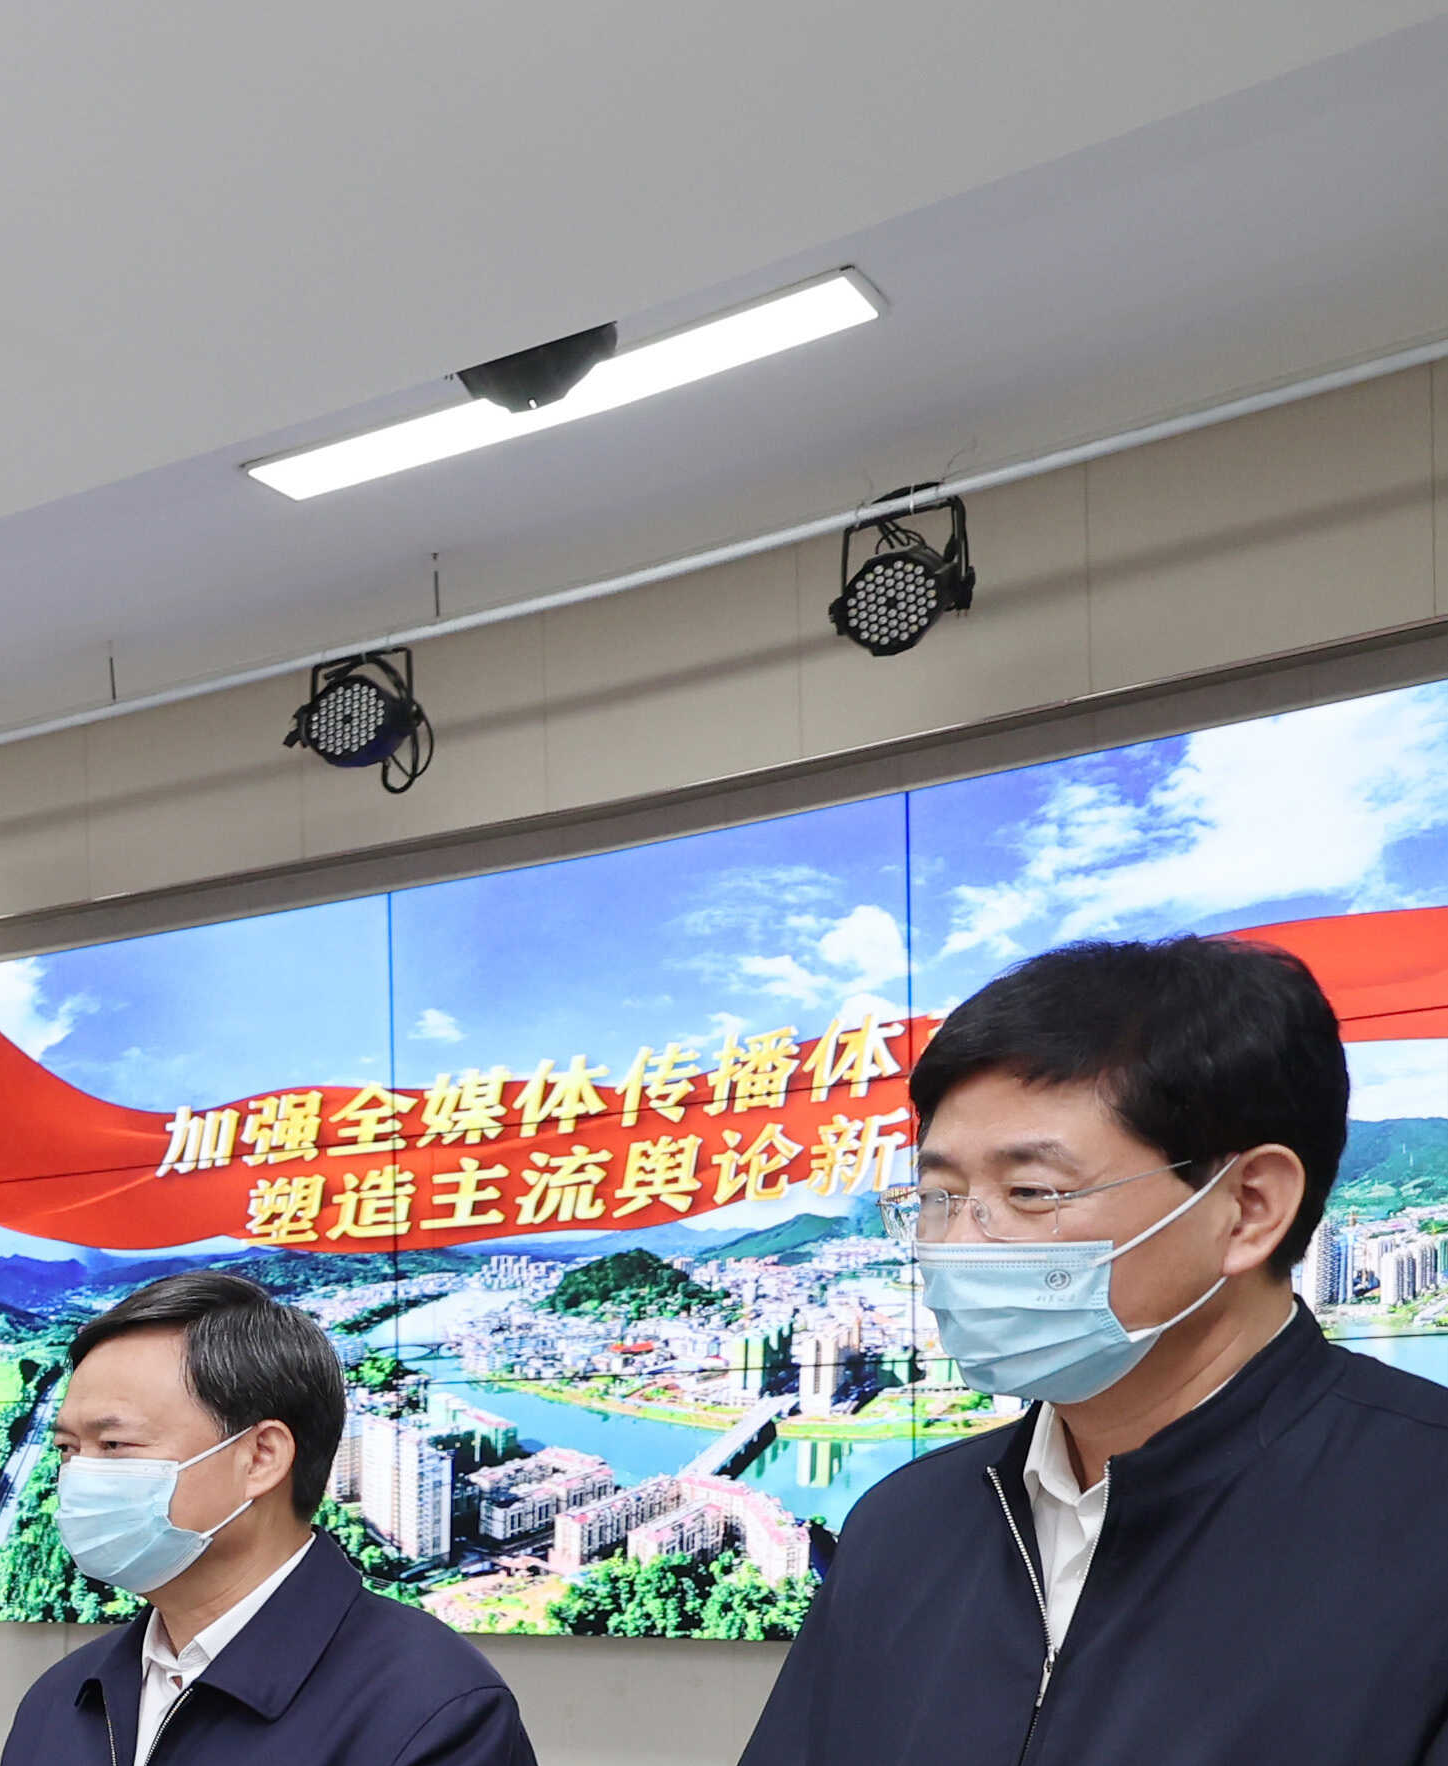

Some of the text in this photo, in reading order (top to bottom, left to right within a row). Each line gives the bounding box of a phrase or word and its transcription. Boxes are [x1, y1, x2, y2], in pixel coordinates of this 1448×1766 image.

[155, 1010, 909, 1179] 加强全媒体传播体
[243, 1106, 910, 1246] 塑造主流舆论新
